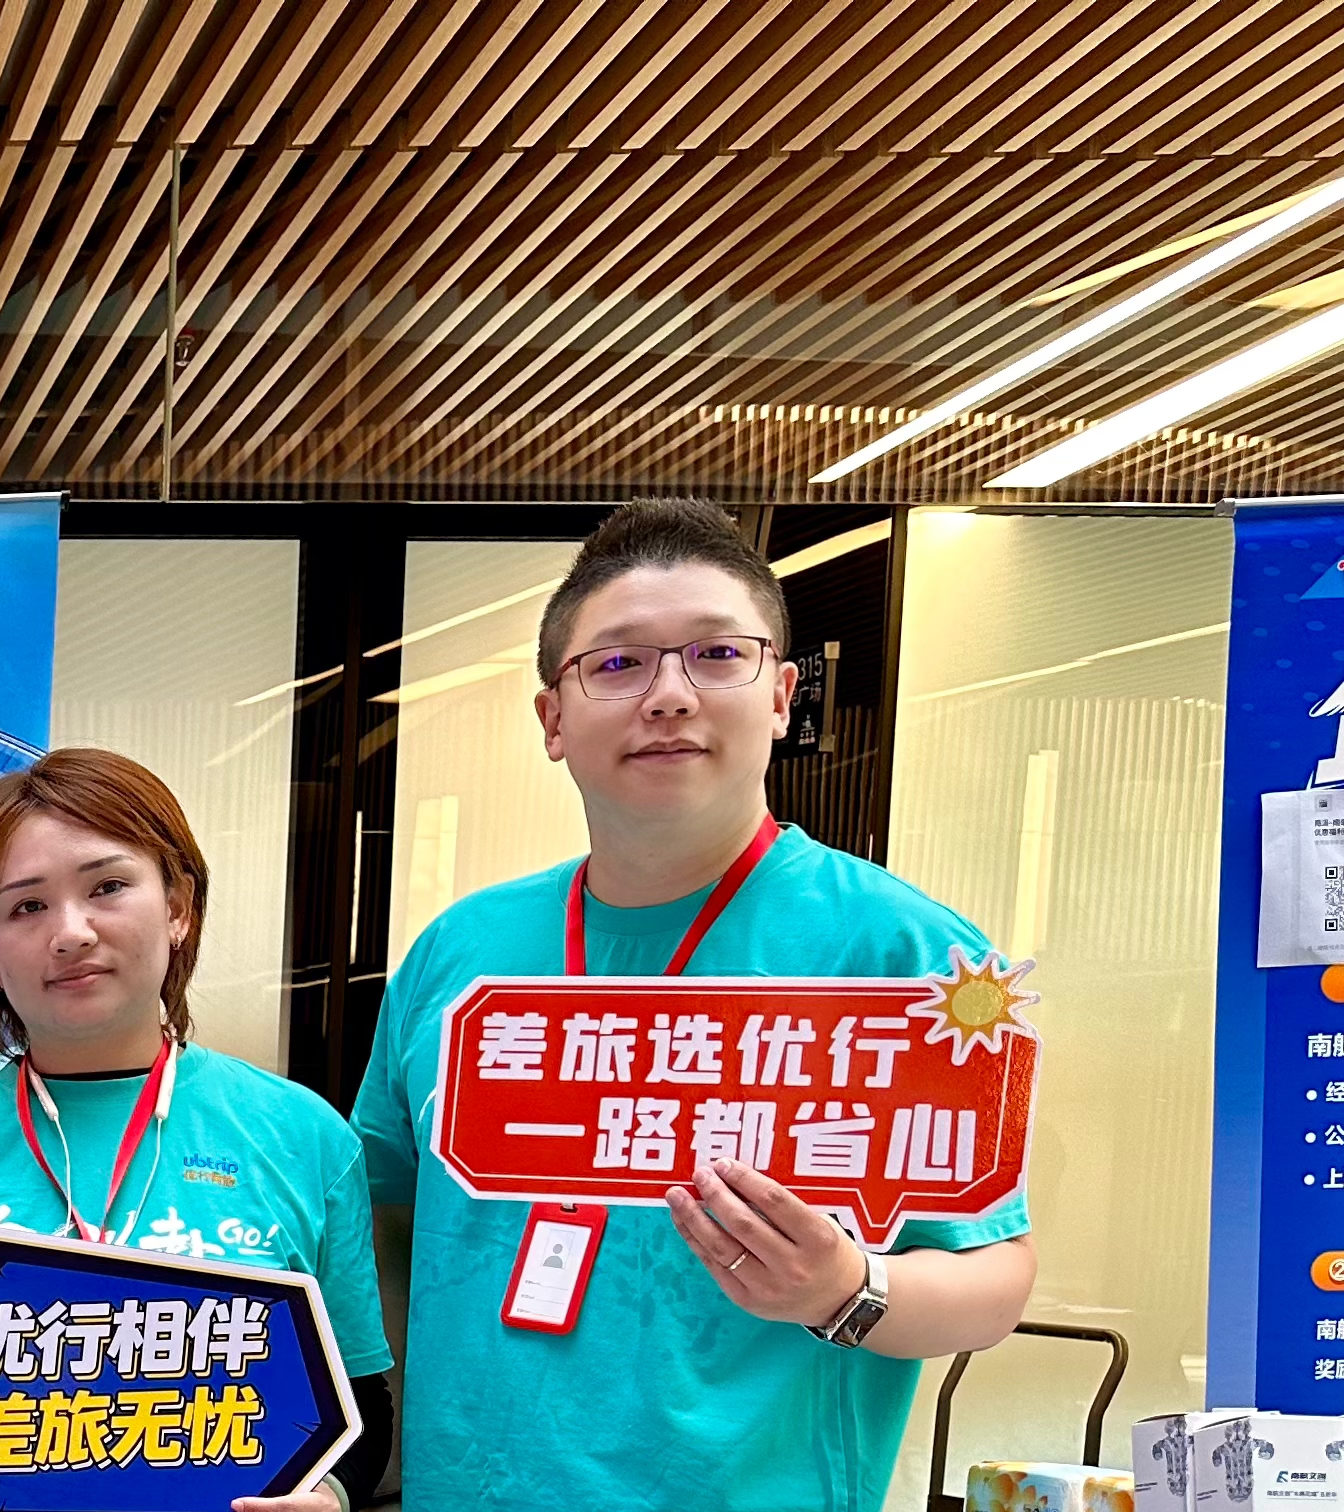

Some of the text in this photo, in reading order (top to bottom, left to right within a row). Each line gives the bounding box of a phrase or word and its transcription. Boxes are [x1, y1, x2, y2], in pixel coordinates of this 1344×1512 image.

[478, 1012, 910, 1089] 差旅选优行
[184, 1153, 238, 1174] ubtrip
[505, 1097, 977, 1183] 一路都省心
